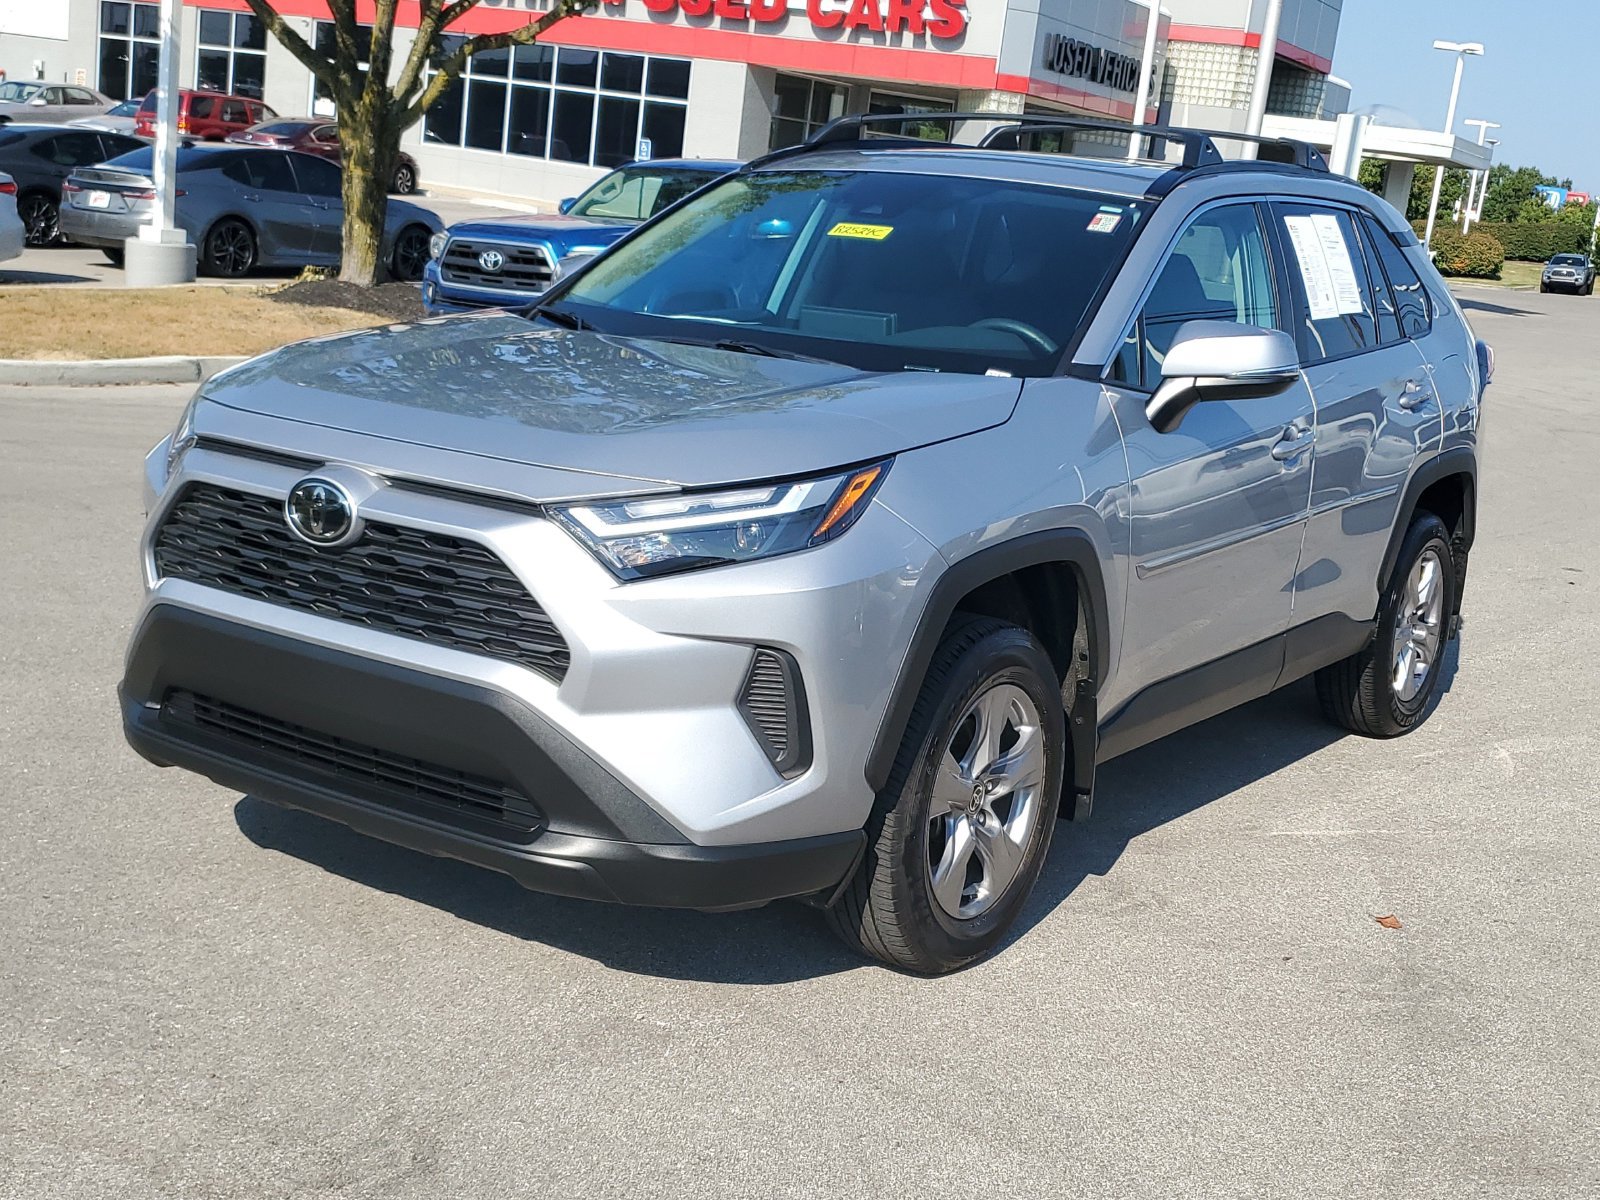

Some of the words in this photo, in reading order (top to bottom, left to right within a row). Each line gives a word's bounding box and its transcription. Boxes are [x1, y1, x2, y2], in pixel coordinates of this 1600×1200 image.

[806, 0, 966, 38] CARS
[1047, 34, 1095, 80] USED
[1096, 48, 1157, 97] VEHICLS
